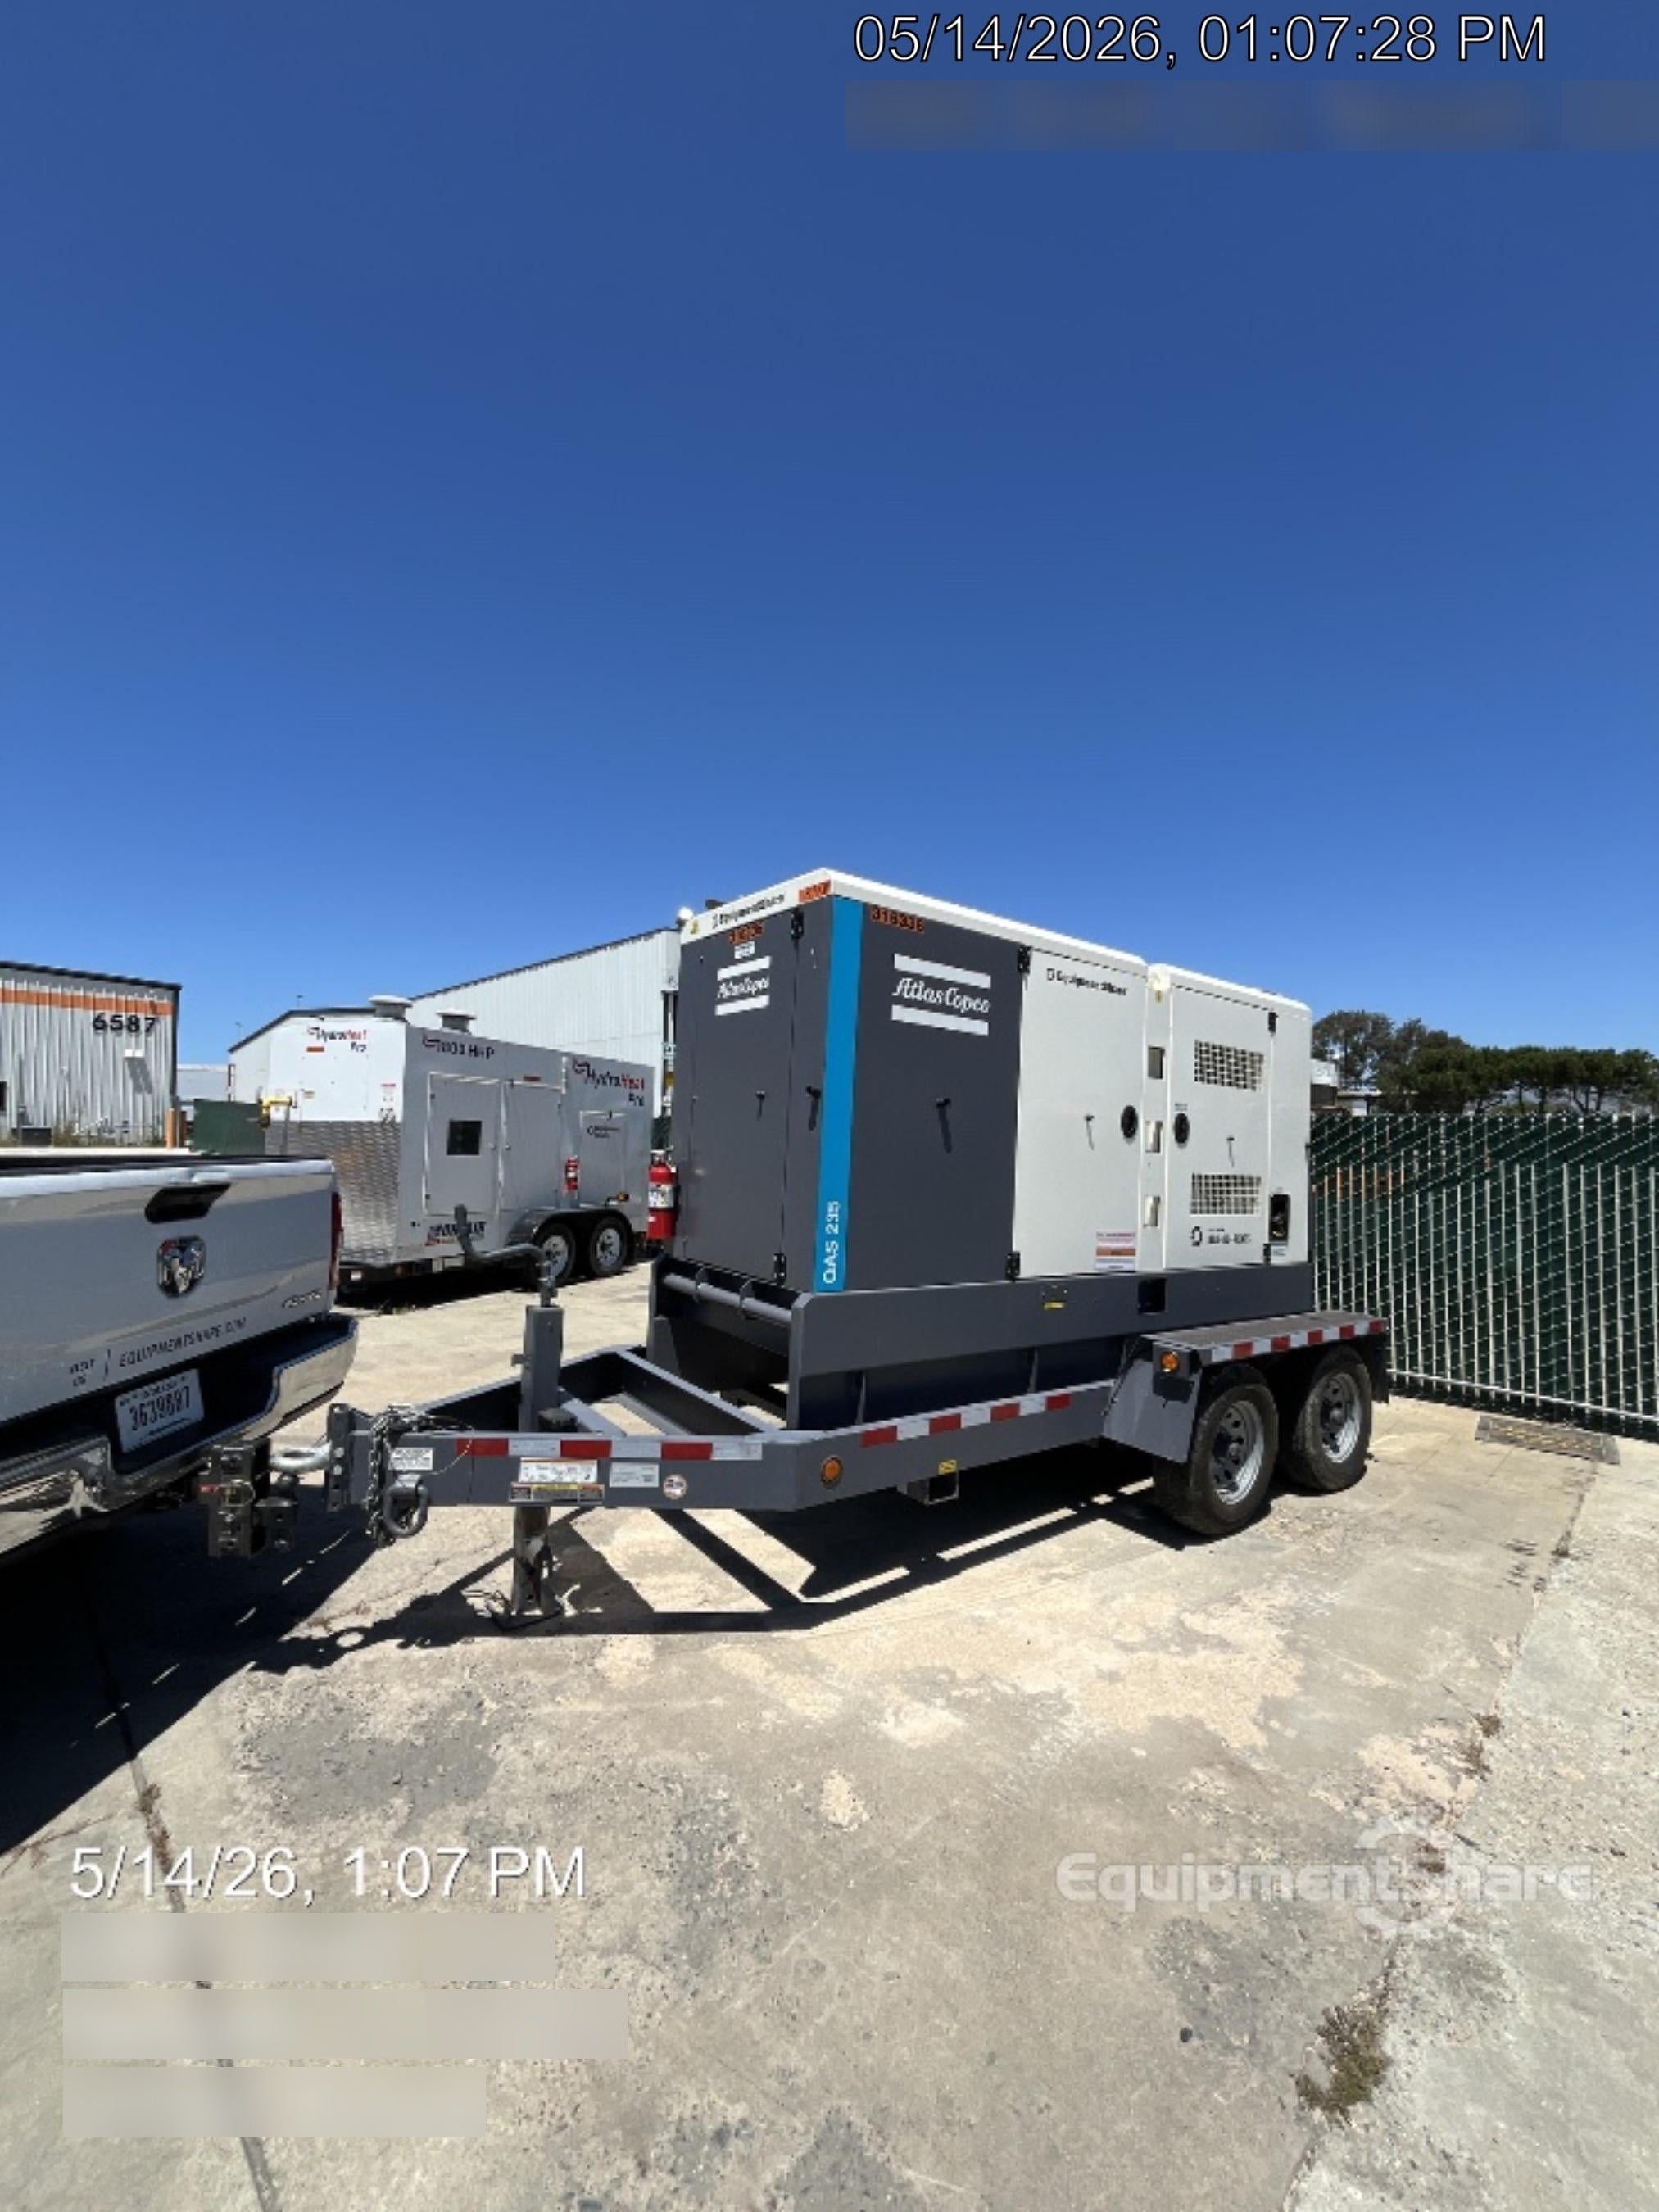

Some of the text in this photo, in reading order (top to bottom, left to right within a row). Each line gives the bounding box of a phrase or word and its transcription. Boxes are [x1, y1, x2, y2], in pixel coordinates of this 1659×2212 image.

[892, 977, 990, 1013] Atlas Copco
[93, 1013, 157, 1034] 6587
[823, 1240, 840, 1285] QAS
